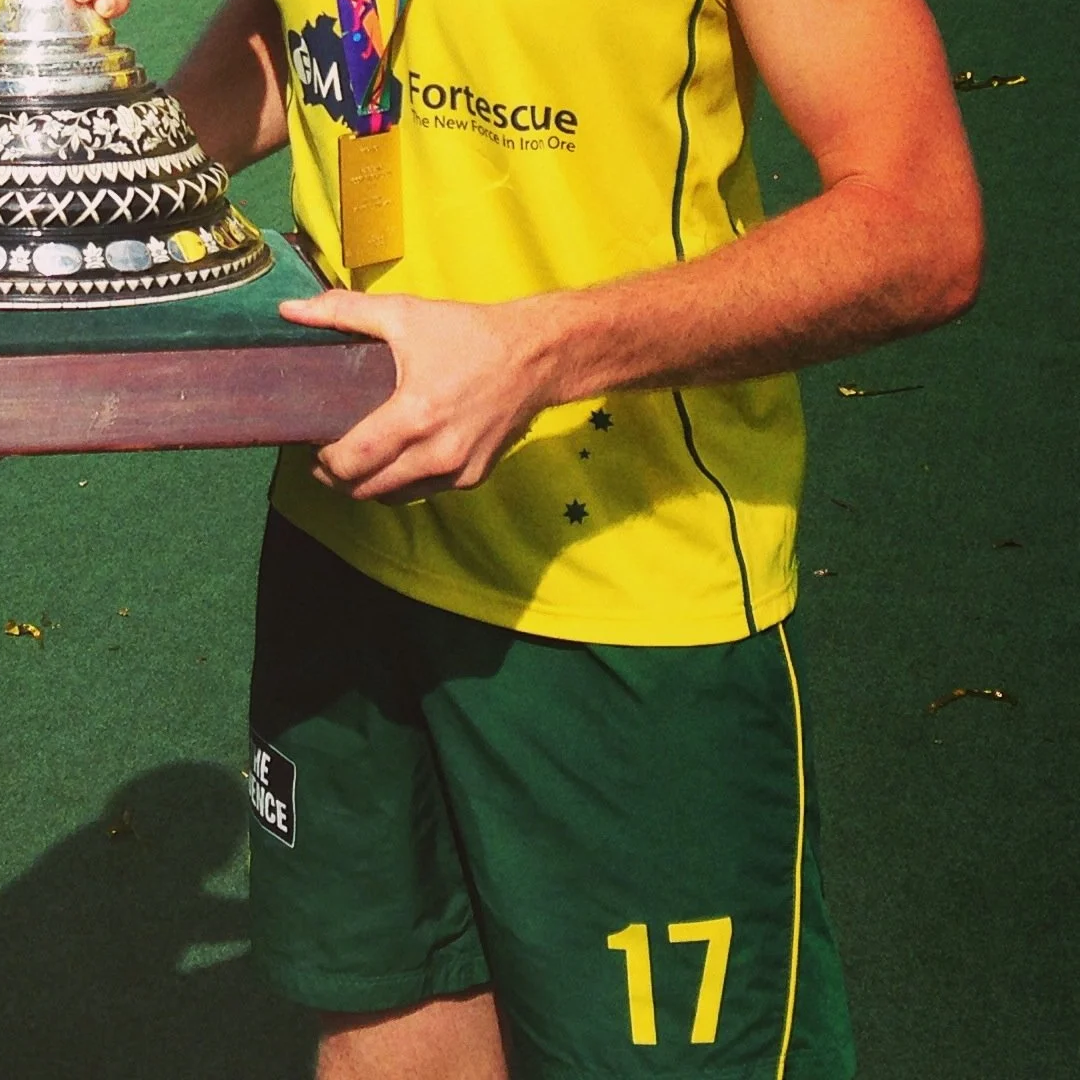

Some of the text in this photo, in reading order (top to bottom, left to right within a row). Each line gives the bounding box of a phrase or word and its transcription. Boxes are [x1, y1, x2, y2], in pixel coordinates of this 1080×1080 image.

[293, 37, 353, 101] FM
[408, 70, 578, 135] Fortescue
[434, 115, 468, 131] New
[471, 120, 500, 144] Force
[502, 137, 515, 150] in
[520, 137, 544, 150] Iron
[547, 135, 576, 152] Ore
[253, 747, 271, 786] HE
[607, 916, 732, 1045] 17
